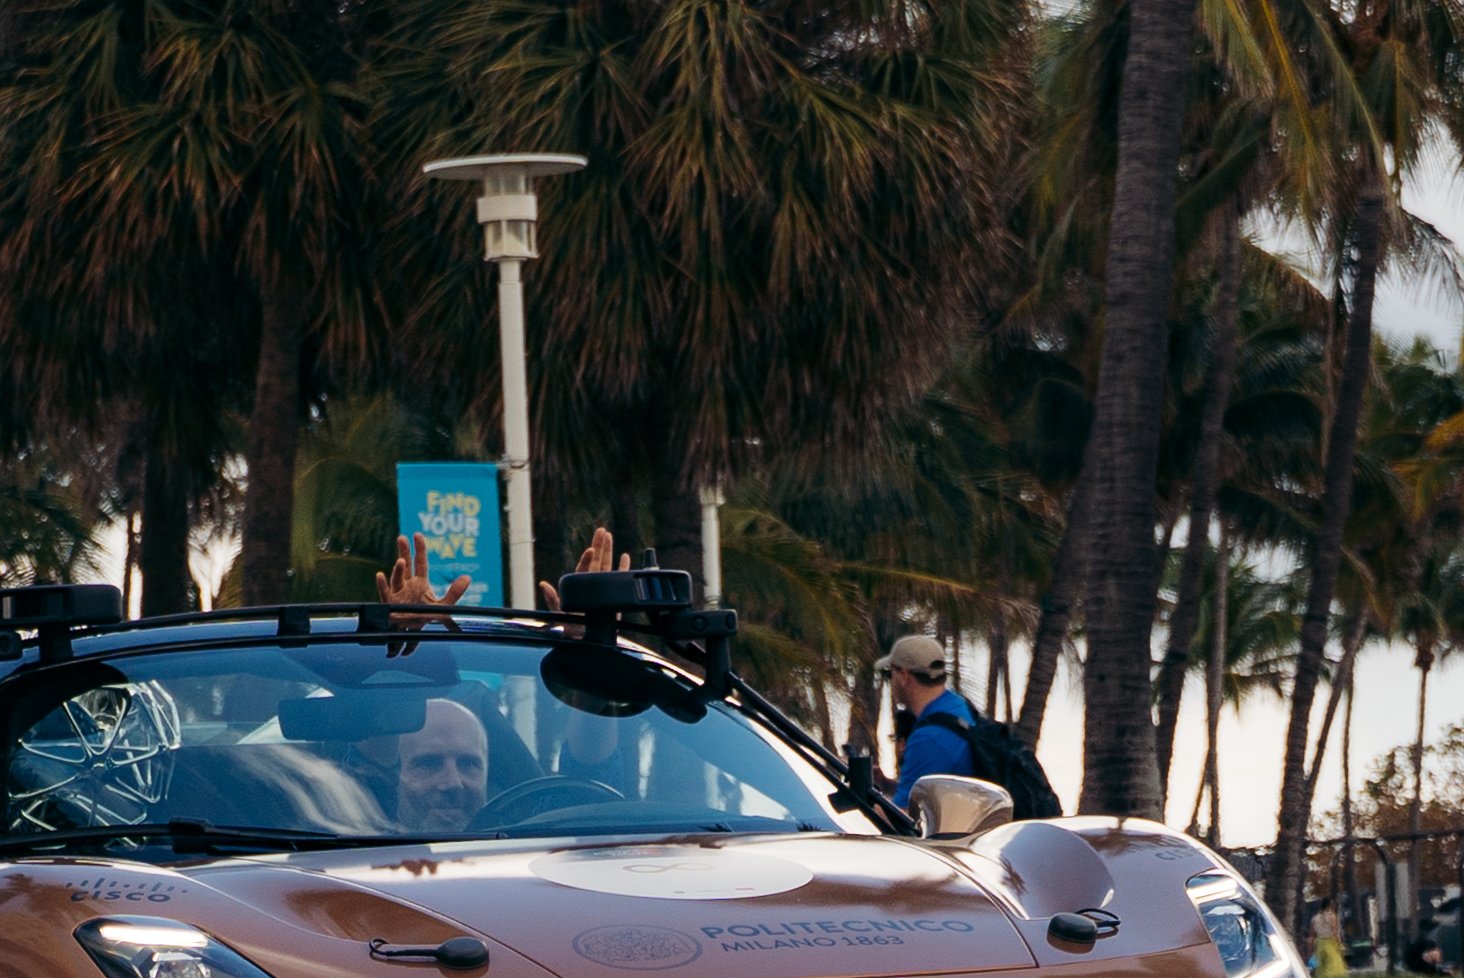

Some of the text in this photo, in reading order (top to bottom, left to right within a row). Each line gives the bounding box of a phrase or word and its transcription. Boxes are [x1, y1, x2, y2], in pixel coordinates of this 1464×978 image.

[427, 490, 481, 517] FIND
[418, 511, 480, 537] YOUR
[424, 533, 478, 559] WAVE
[700, 919, 974, 939] POLITECNICO
[721, 935, 905, 952] MILANO 1863
